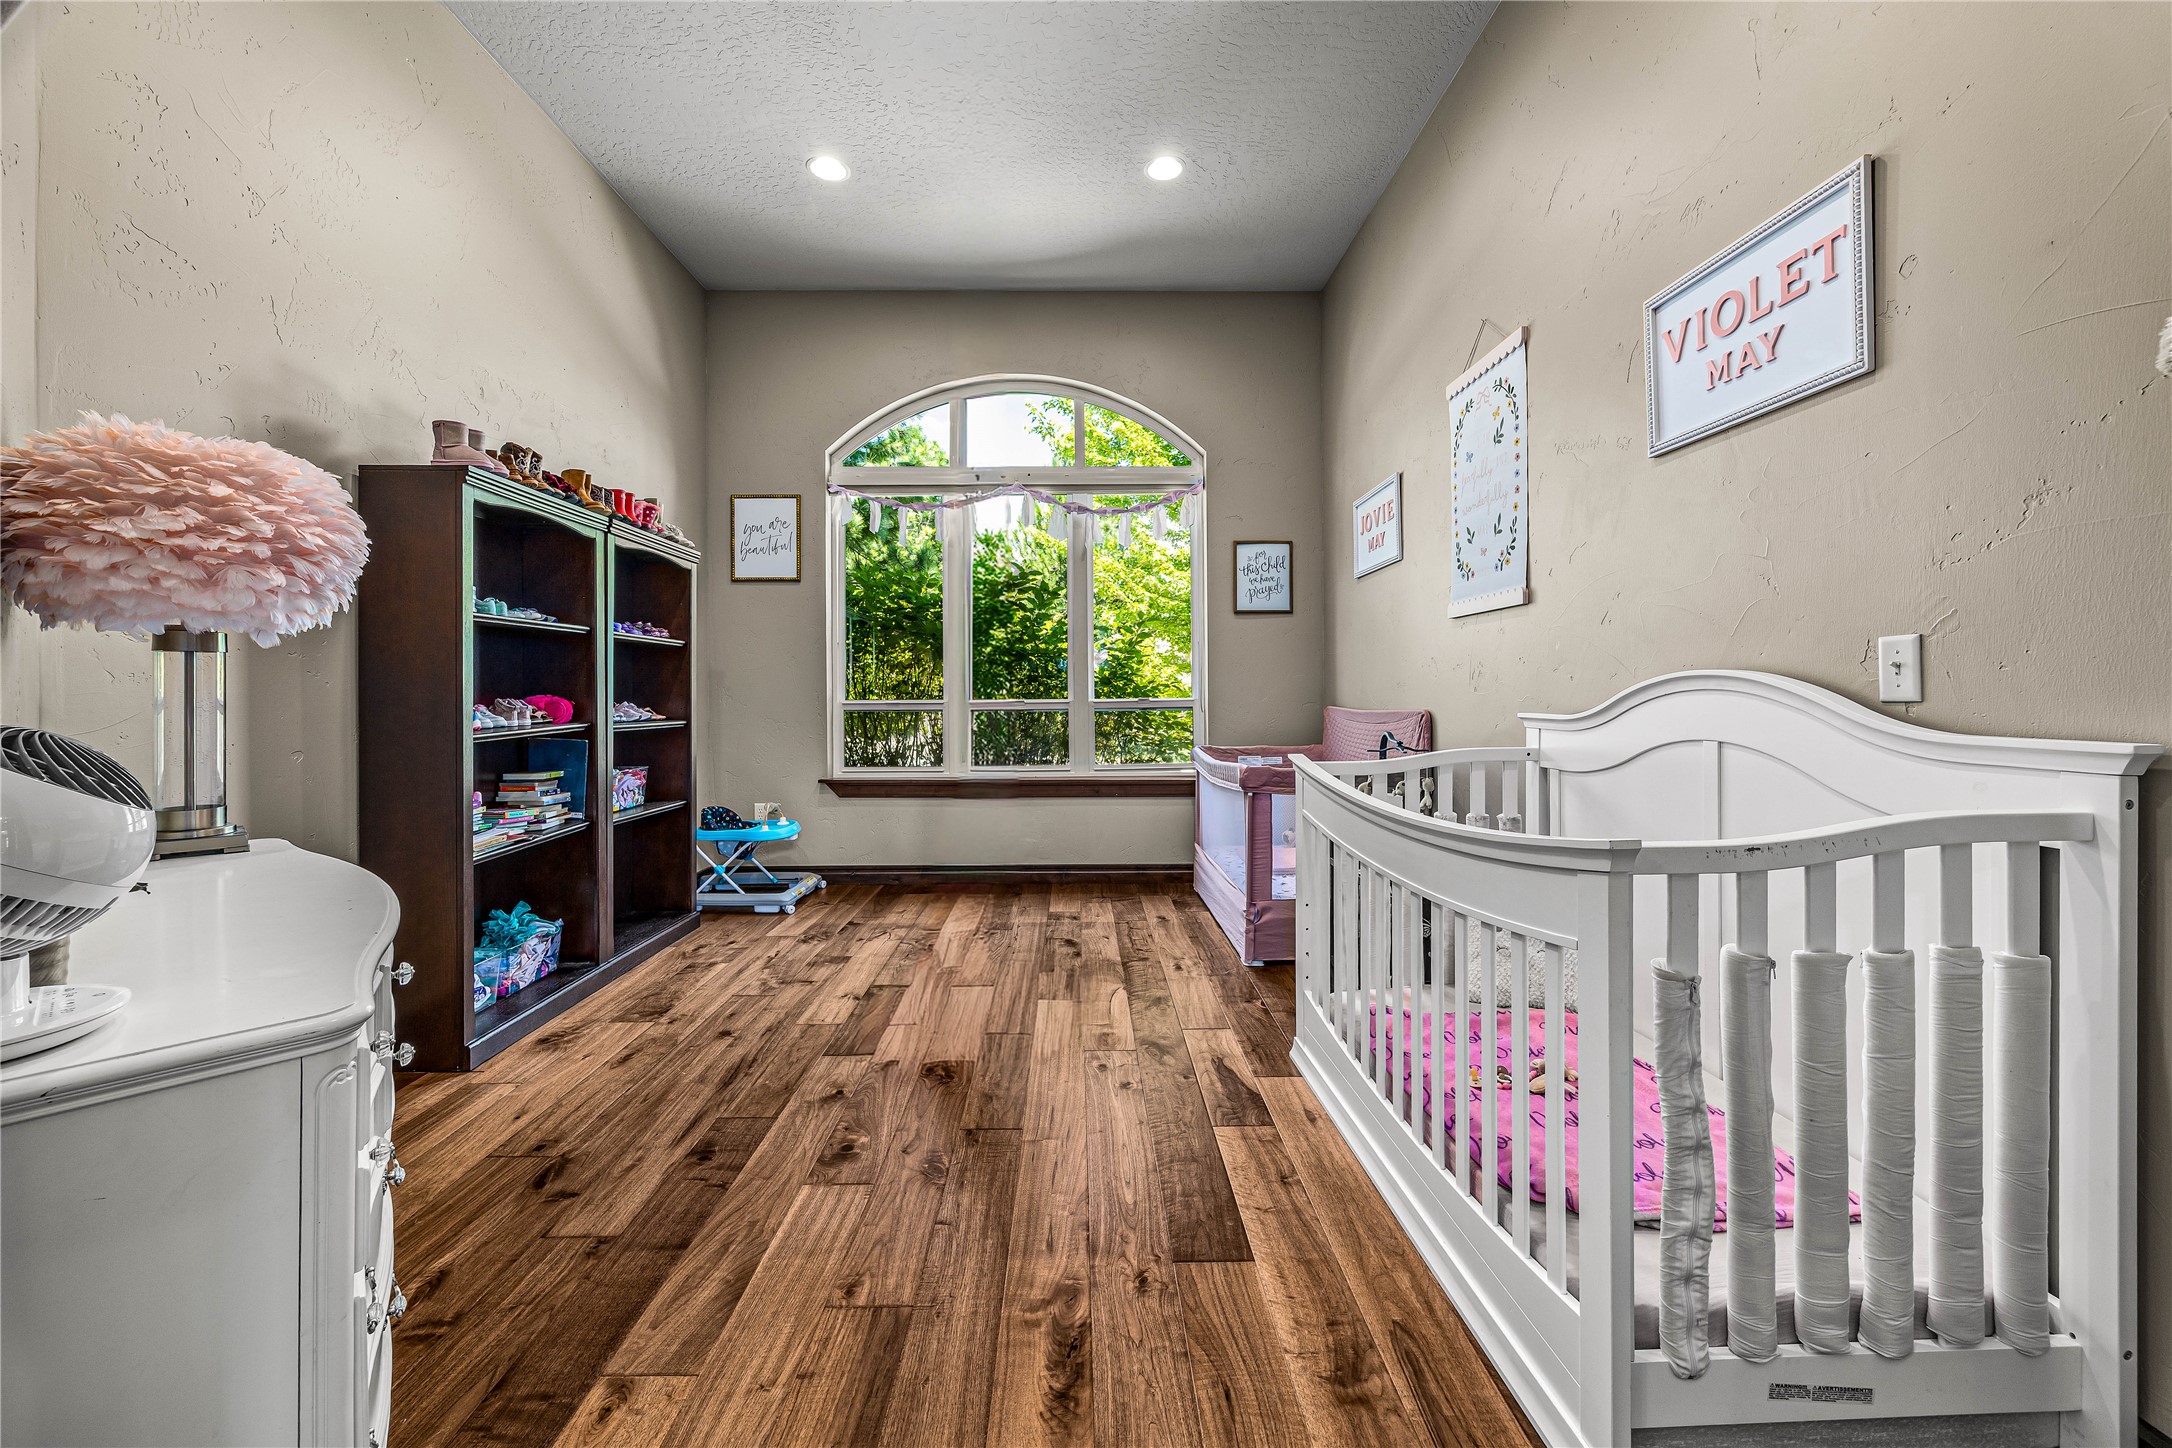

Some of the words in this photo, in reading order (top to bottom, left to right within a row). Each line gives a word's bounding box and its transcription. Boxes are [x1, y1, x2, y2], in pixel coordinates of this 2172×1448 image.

[1661, 224, 1848, 364] VIOLET
[1705, 323, 1785, 391] MAY
[1360, 498, 1395, 536] JOVIE
[743, 523, 766, 547] you
[768, 517, 791, 533] are
[1367, 531, 1386, 553] MAY
[740, 531, 793, 562] beautiful
[1253, 550, 1267, 565] for
[1239, 563, 1260, 577] this
[1259, 573, 1276, 585] have
[1245, 577, 1282, 604] prayed
